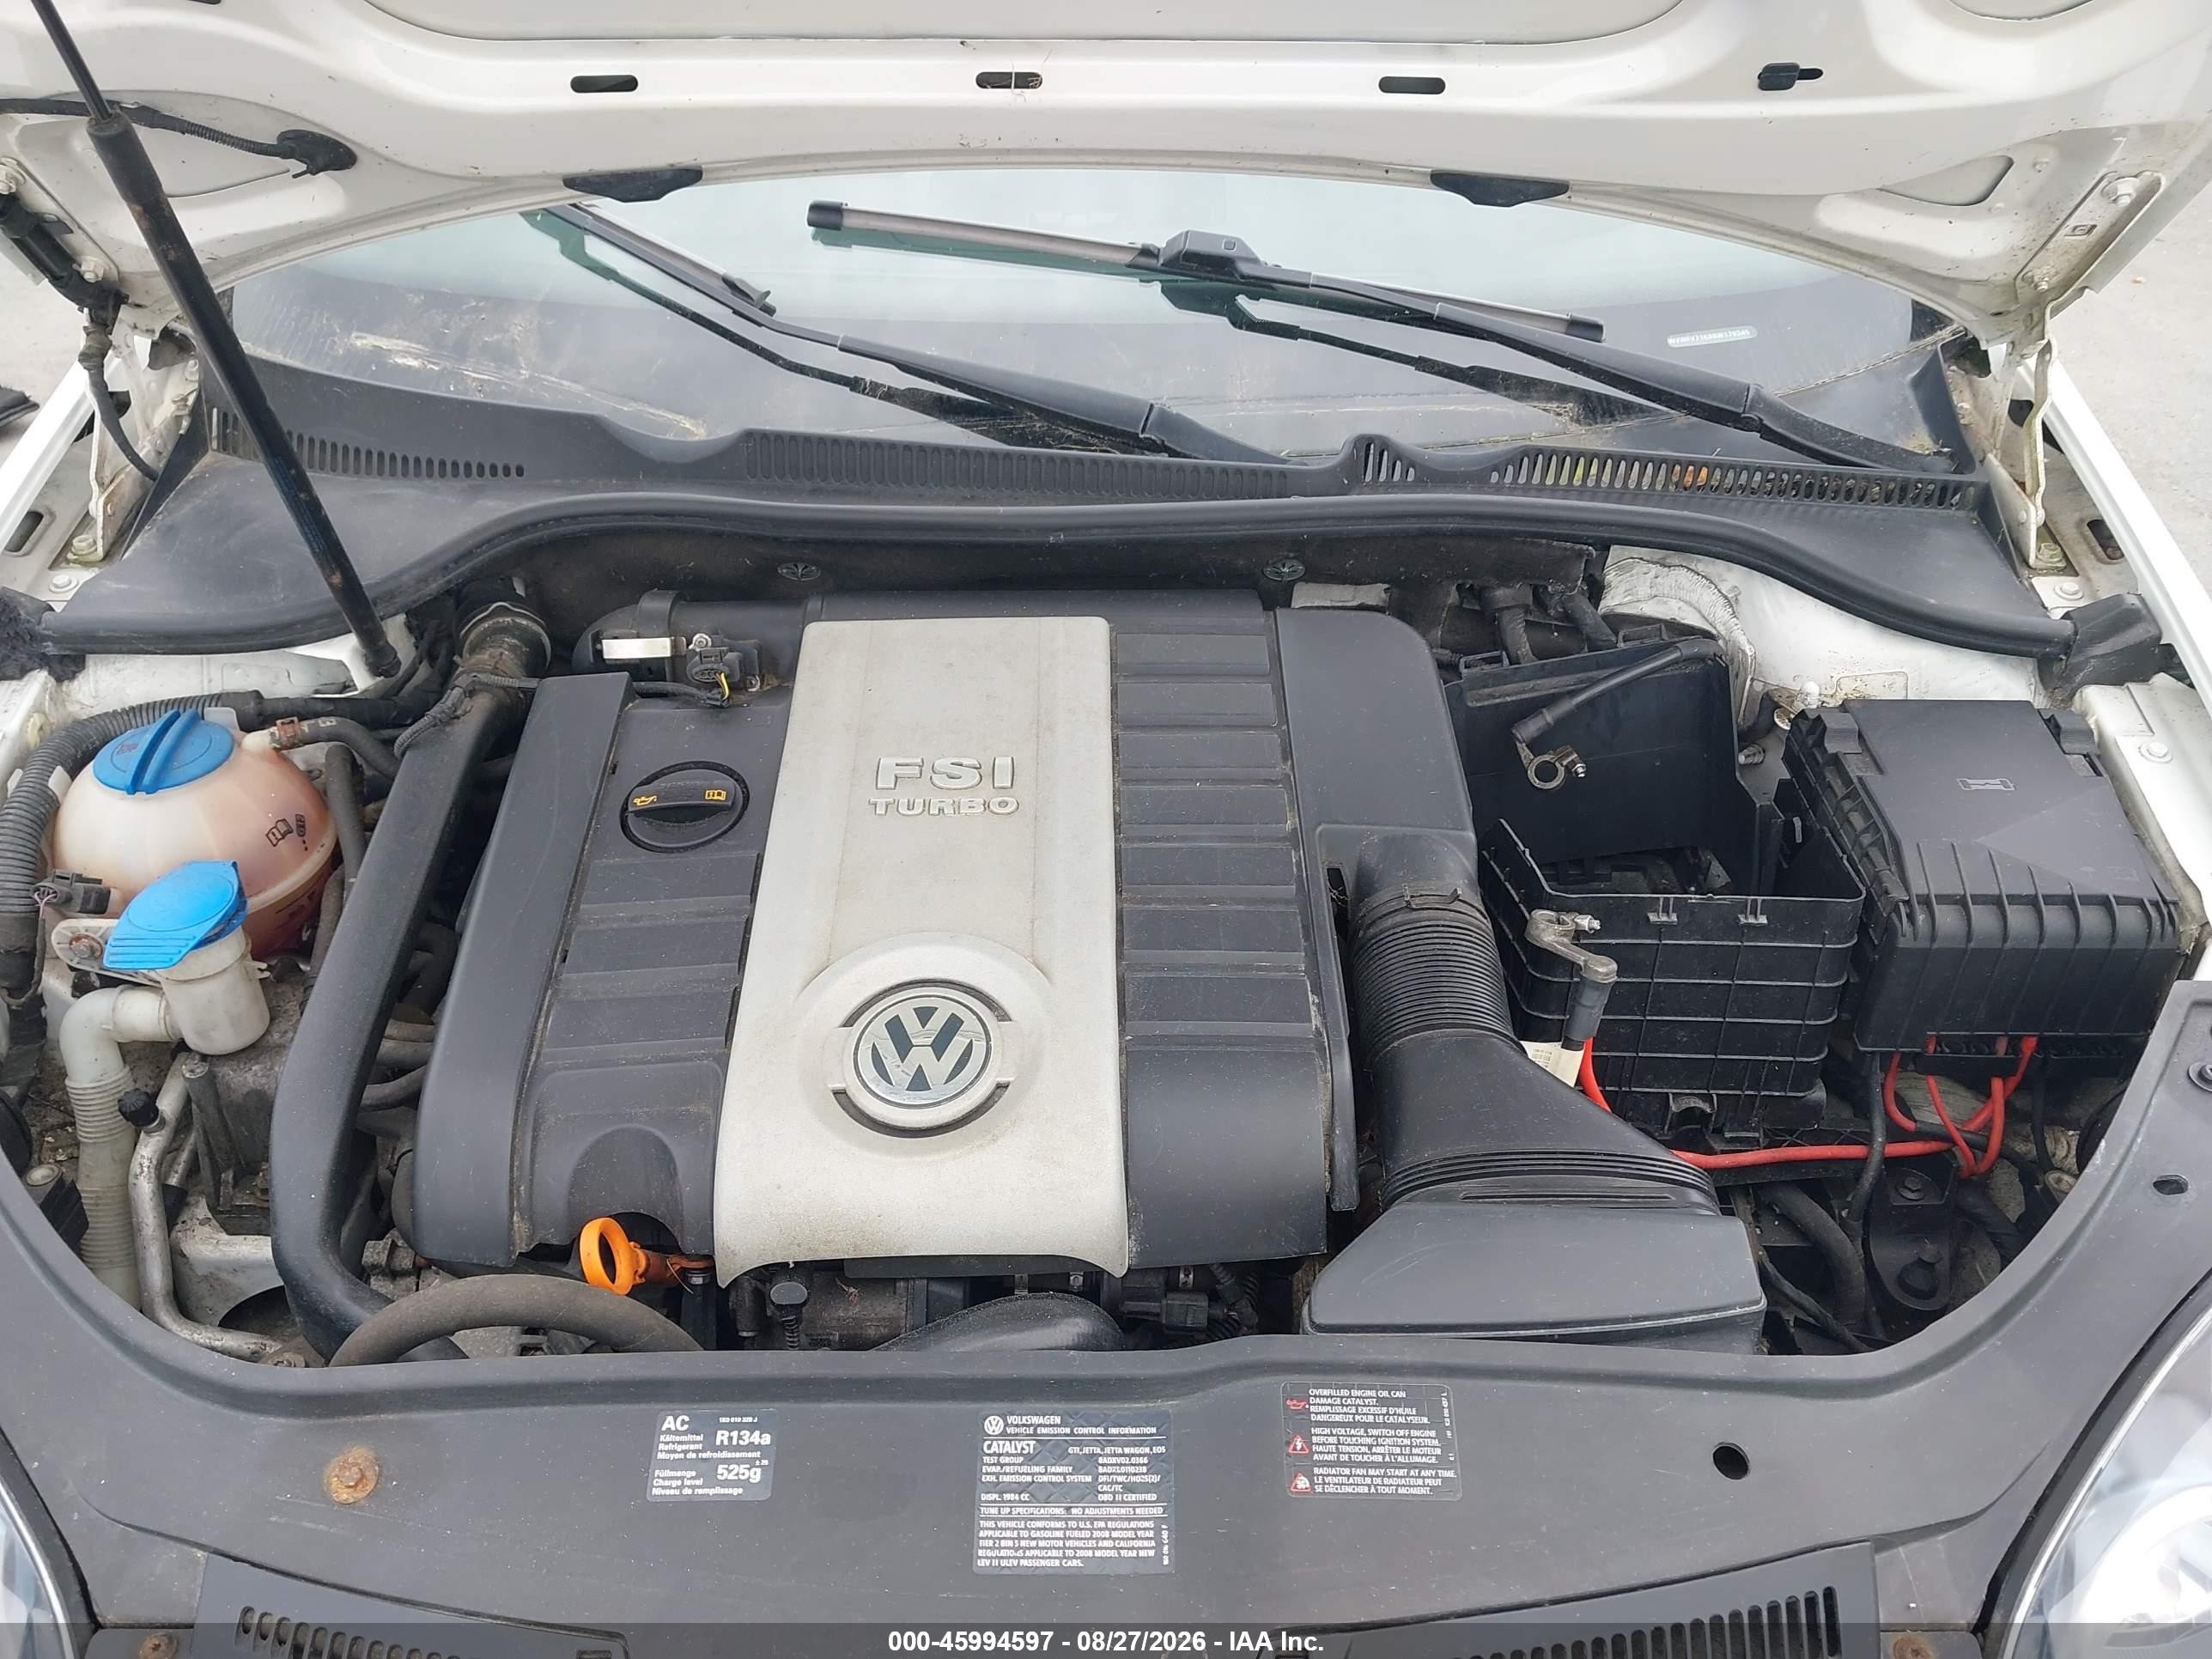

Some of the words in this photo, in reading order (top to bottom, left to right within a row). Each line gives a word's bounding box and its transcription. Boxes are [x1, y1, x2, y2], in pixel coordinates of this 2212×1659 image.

[875, 756, 1015, 790] FSI
[868, 797, 1019, 817] TURBO
[1309, 1389, 1349, 1397] OVERFILLED
[1310, 1406, 1356, 1414] REMPLISSAGE
[661, 1415, 690, 1431] AC
[1006, 1416, 1061, 1425] VOLKSWAGEN
[1310, 1414, 1353, 1423] DANGEREUX
[1385, 1415, 1431, 1424] CATALYSEUR.
[1396, 1429, 1408, 1437] OFF
[715, 1431, 771, 1445] R134a
[1340, 1437, 1376, 1445] TOUCHING
[658, 1443, 702, 1451] Refrigerant
[983, 1441, 1036, 1454] CATALYST
[657, 1451, 684, 1460] Moyen
[1391, 1455, 1438, 1463] L'ALLUMAGE.
[716, 1465, 762, 1483] 525g
[1314, 1468, 1350, 1476] RADIATOR
[1352, 1468, 1366, 1476] FAN
[1387, 1468, 1407, 1477] START
[653, 1478, 681, 1487] Charge
[684, 1478, 703, 1486] level
[1325, 1476, 1371, 1485] VENTILATEUR
[1383, 1477, 1423, 1486] RADIATEUR
[652, 1487, 679, 1496] Niveau
[683, 1487, 692, 1496] de
[695, 1487, 743, 1496] remplissage
[1315, 1485, 1322, 1493] SE
[1378, 1486, 1395, 1494] TOUT
[1398, 1486, 1433, 1495] MOMENT.
